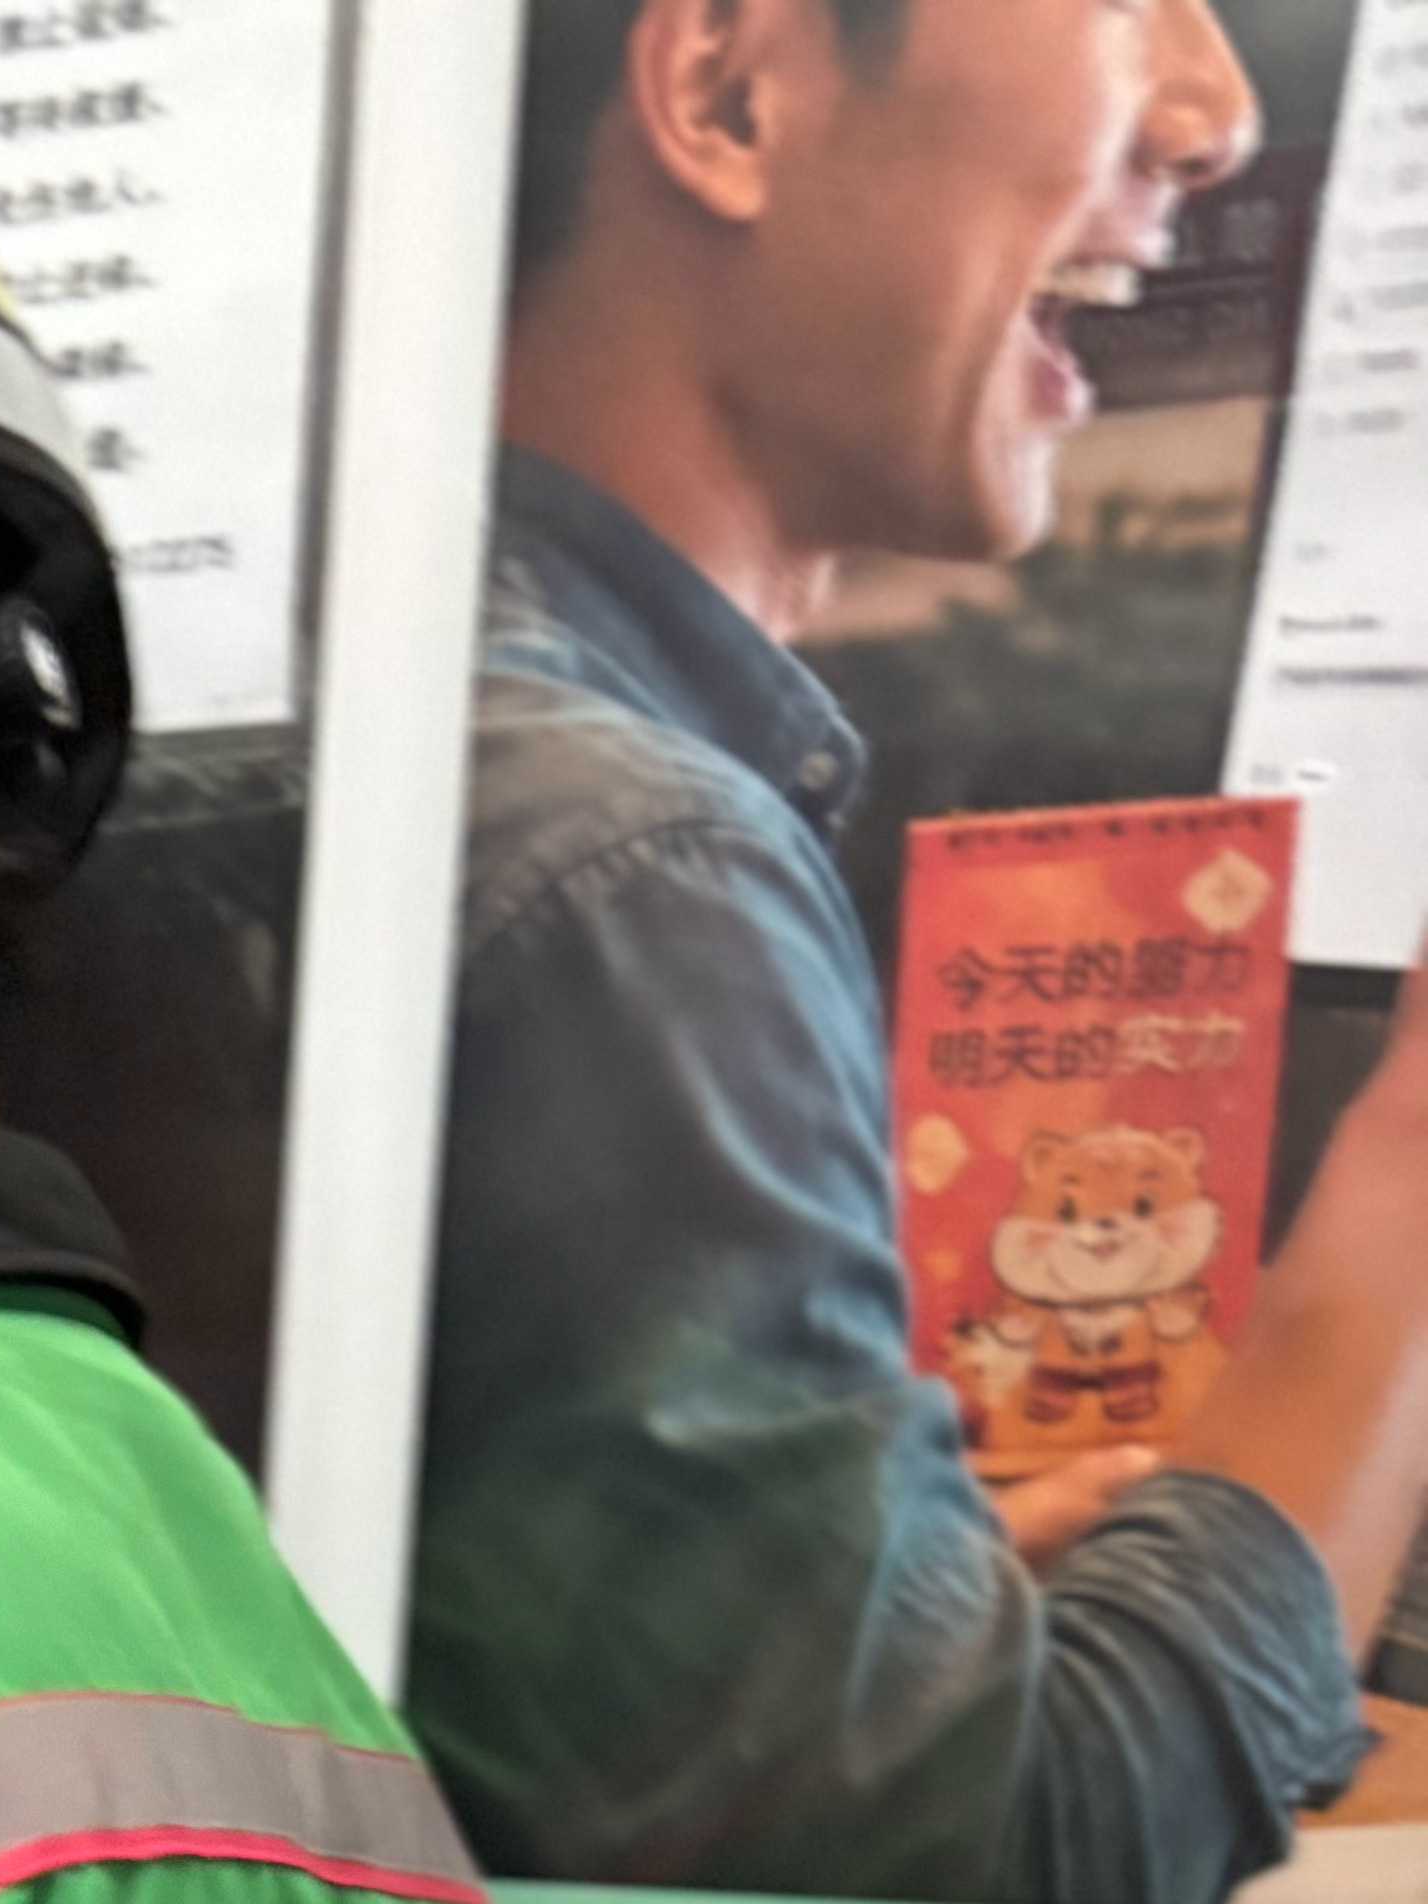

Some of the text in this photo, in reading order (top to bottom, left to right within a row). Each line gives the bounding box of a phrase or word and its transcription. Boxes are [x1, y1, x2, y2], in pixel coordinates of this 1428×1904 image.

[928, 1009, 1246, 1089] 明天的实力
